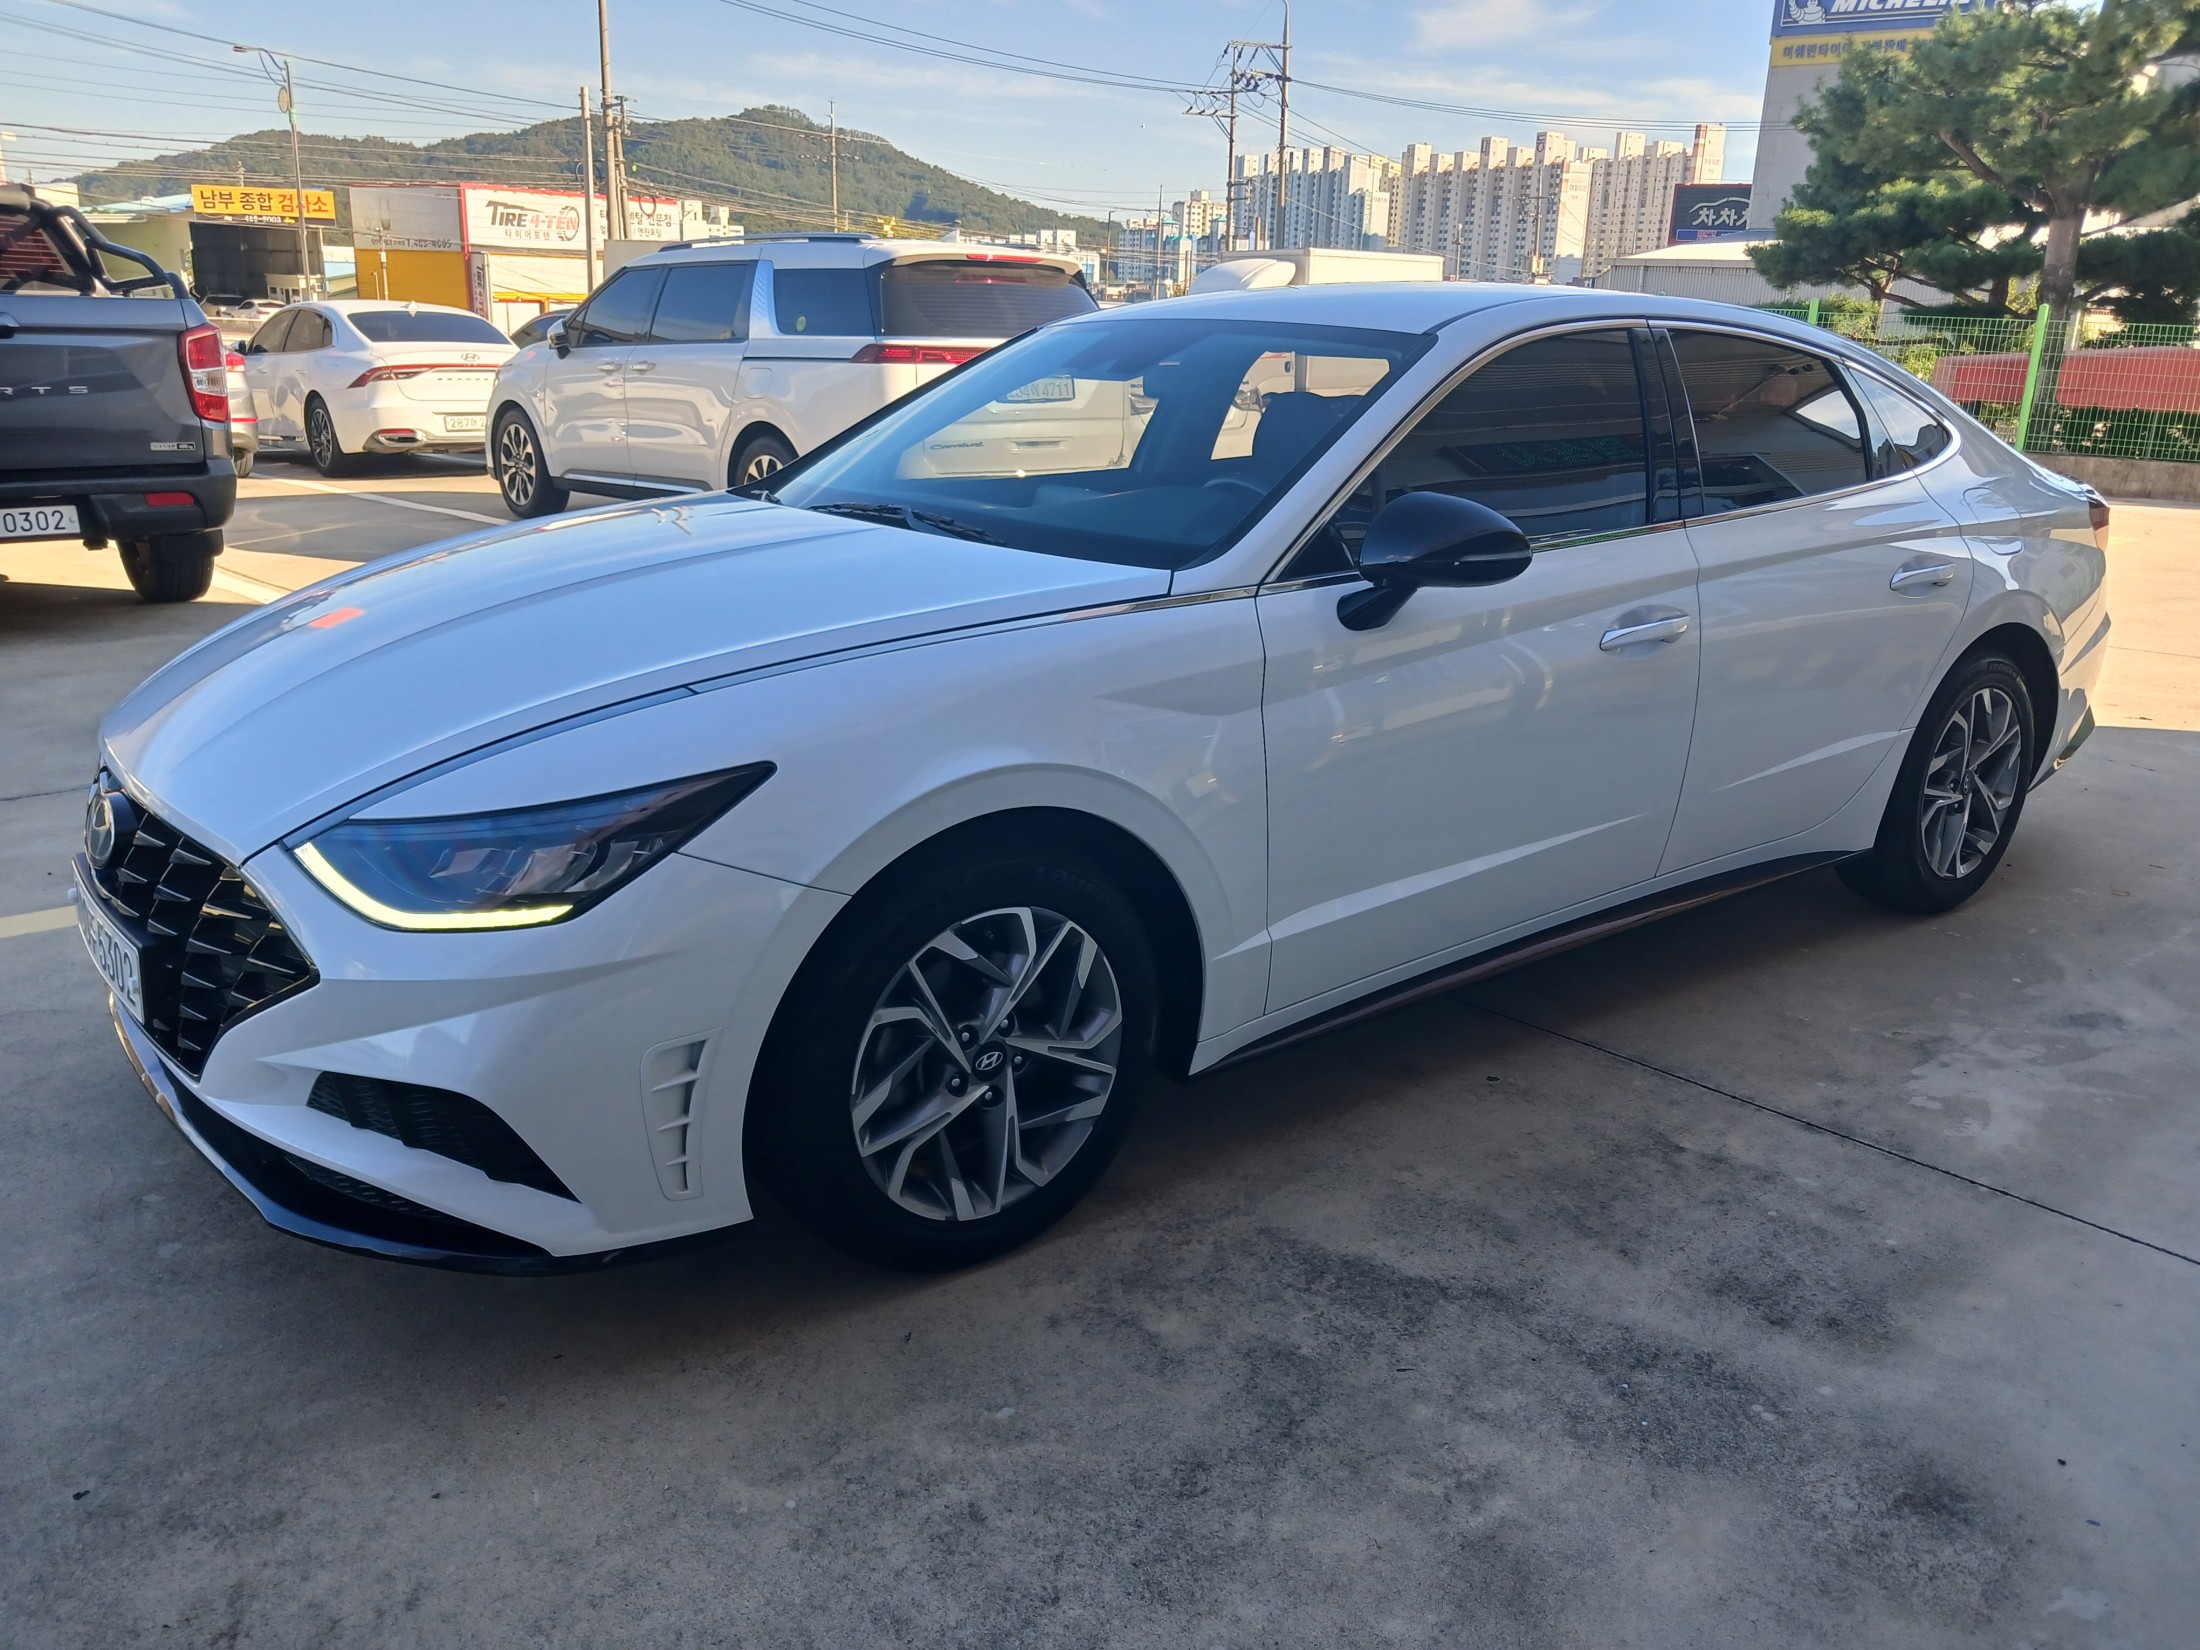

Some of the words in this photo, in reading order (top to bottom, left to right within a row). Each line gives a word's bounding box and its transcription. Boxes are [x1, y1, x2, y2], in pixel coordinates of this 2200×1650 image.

[200, 190, 235, 210] 남부
[239, 192, 273, 211] 종합
[278, 194, 329, 213] 검사소
[485, 200, 536, 228] TIRE
[3, 510, 66, 533] 0302
